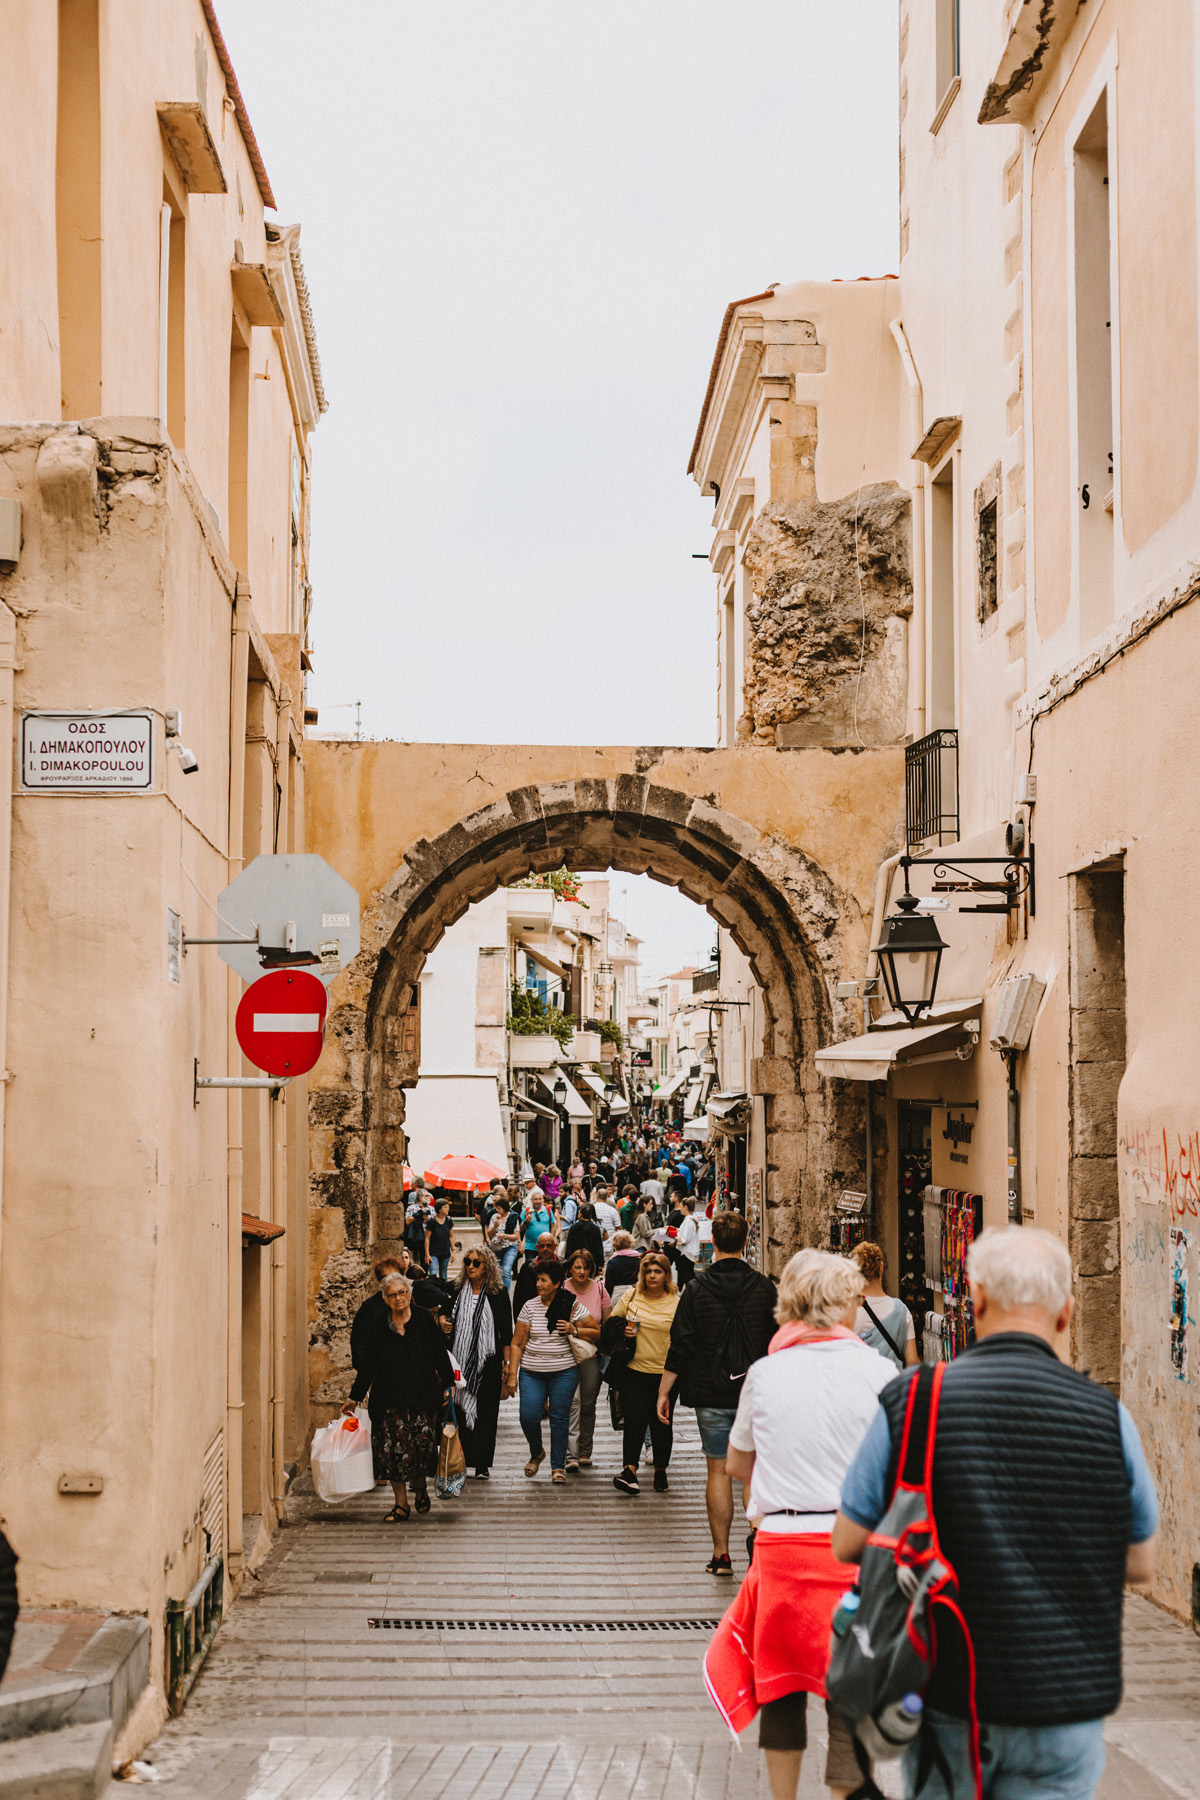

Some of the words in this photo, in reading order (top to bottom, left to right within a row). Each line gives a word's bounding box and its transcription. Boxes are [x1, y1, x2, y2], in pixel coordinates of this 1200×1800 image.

[68, 723, 106, 733] ΟΔΟΣ
[40, 740, 146, 754] ΔΗΜΑΚΟΠΟΥΛΟΥ
[30, 761, 37, 771] I.
[41, 760, 144, 771] DIMAKOPOULOU
